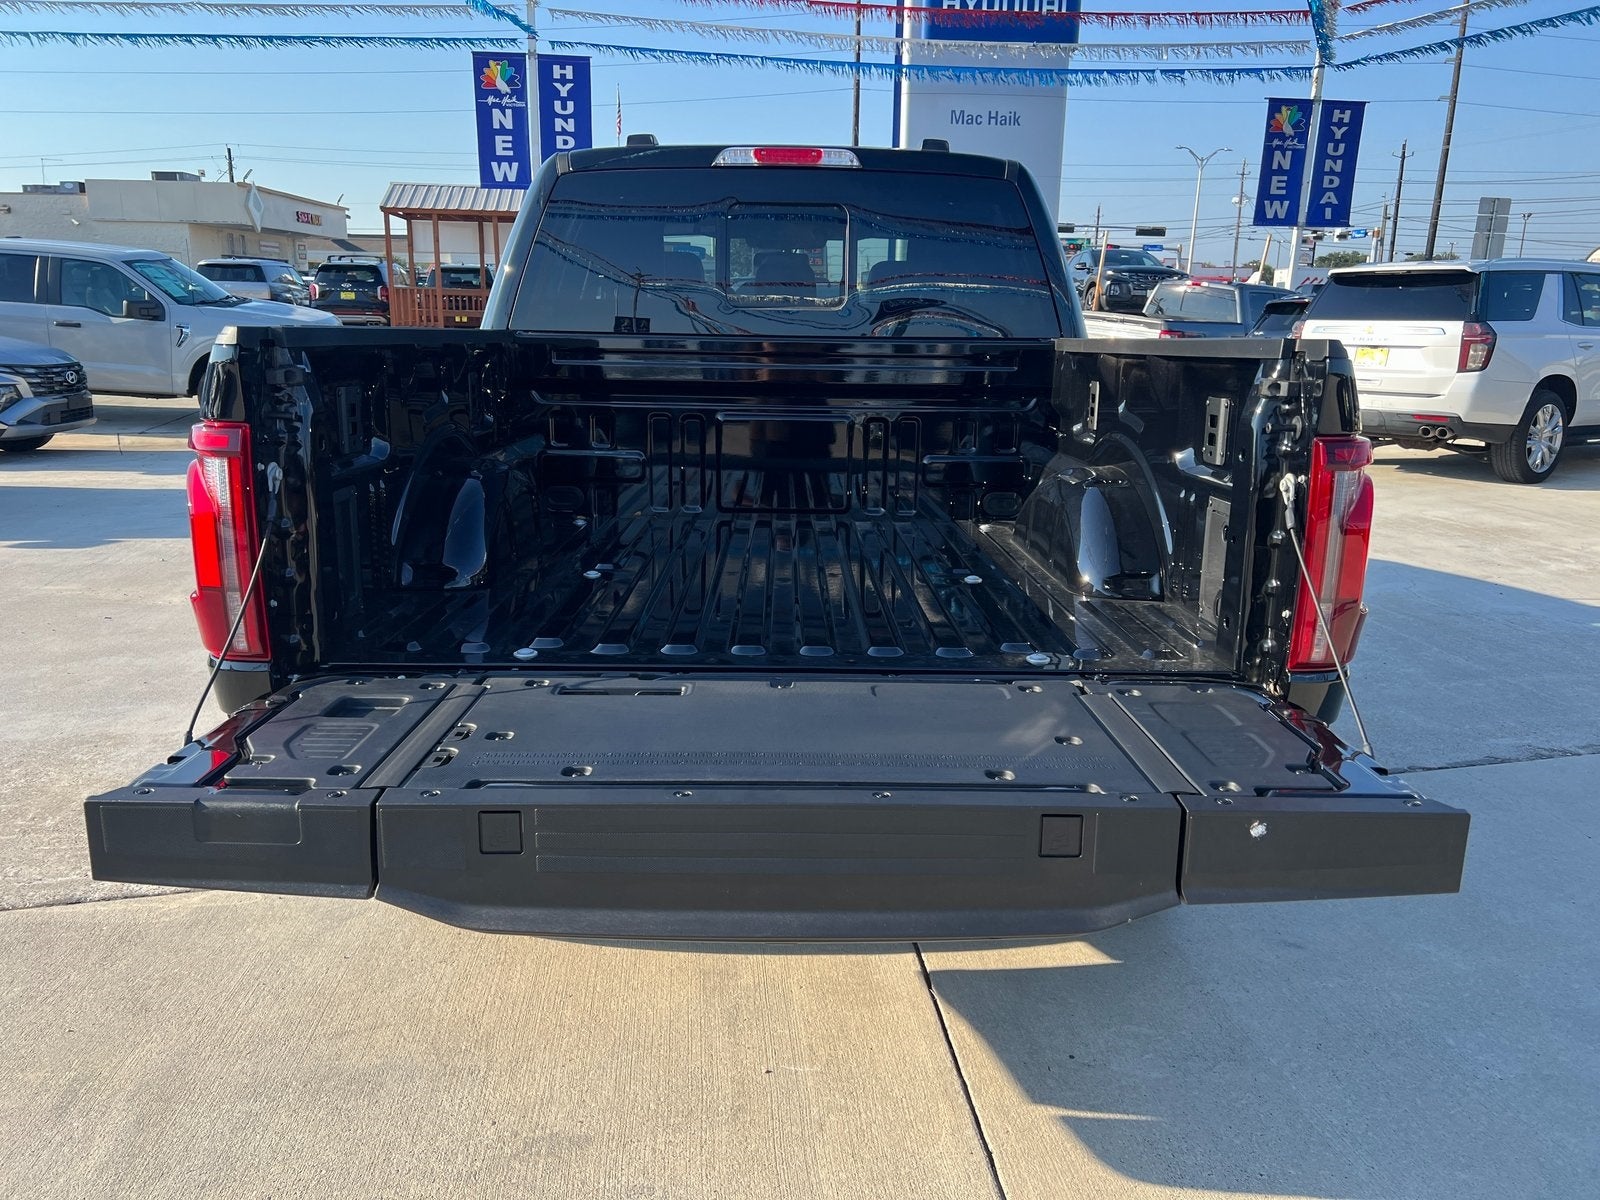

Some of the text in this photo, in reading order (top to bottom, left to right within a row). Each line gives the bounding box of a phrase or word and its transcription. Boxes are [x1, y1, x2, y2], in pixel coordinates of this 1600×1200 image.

[490, 108, 519, 183] NEW
[950, 109, 1021, 127] Mac Haik
[1263, 150, 1293, 219] NEW
[1319, 109, 1352, 220] HYUNDAI
